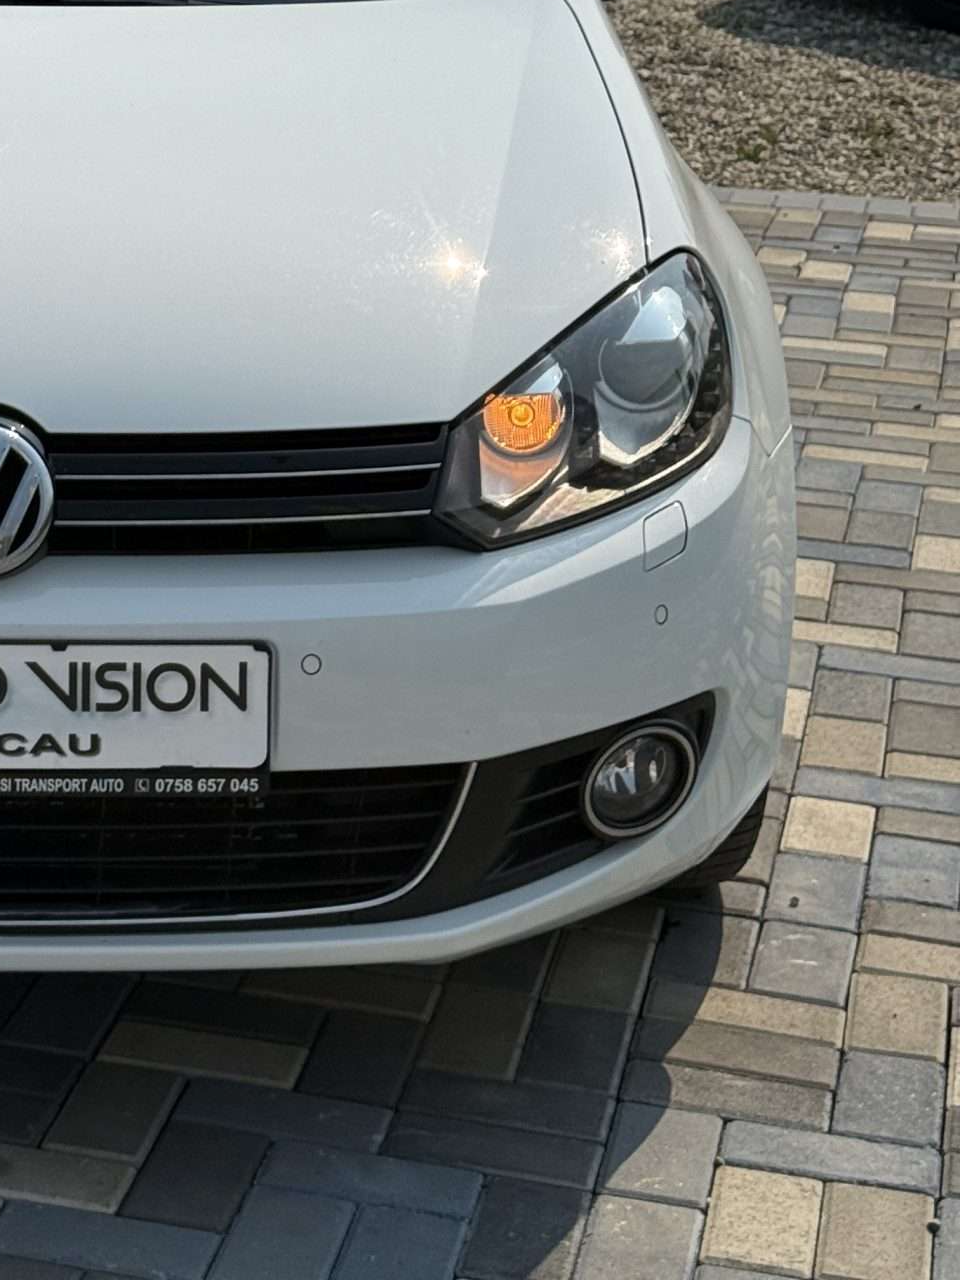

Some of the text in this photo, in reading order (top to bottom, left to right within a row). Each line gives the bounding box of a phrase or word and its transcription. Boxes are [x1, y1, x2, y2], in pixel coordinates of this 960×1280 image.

[24, 661, 248, 712] VISION
[0, 778, 13, 792] SI
[14, 778, 88, 793] TRANSPORT
[90, 778, 124, 793] AUTO
[154, 778, 193, 793] 0758
[197, 778, 226, 793] 657
[229, 778, 259, 793] 045
